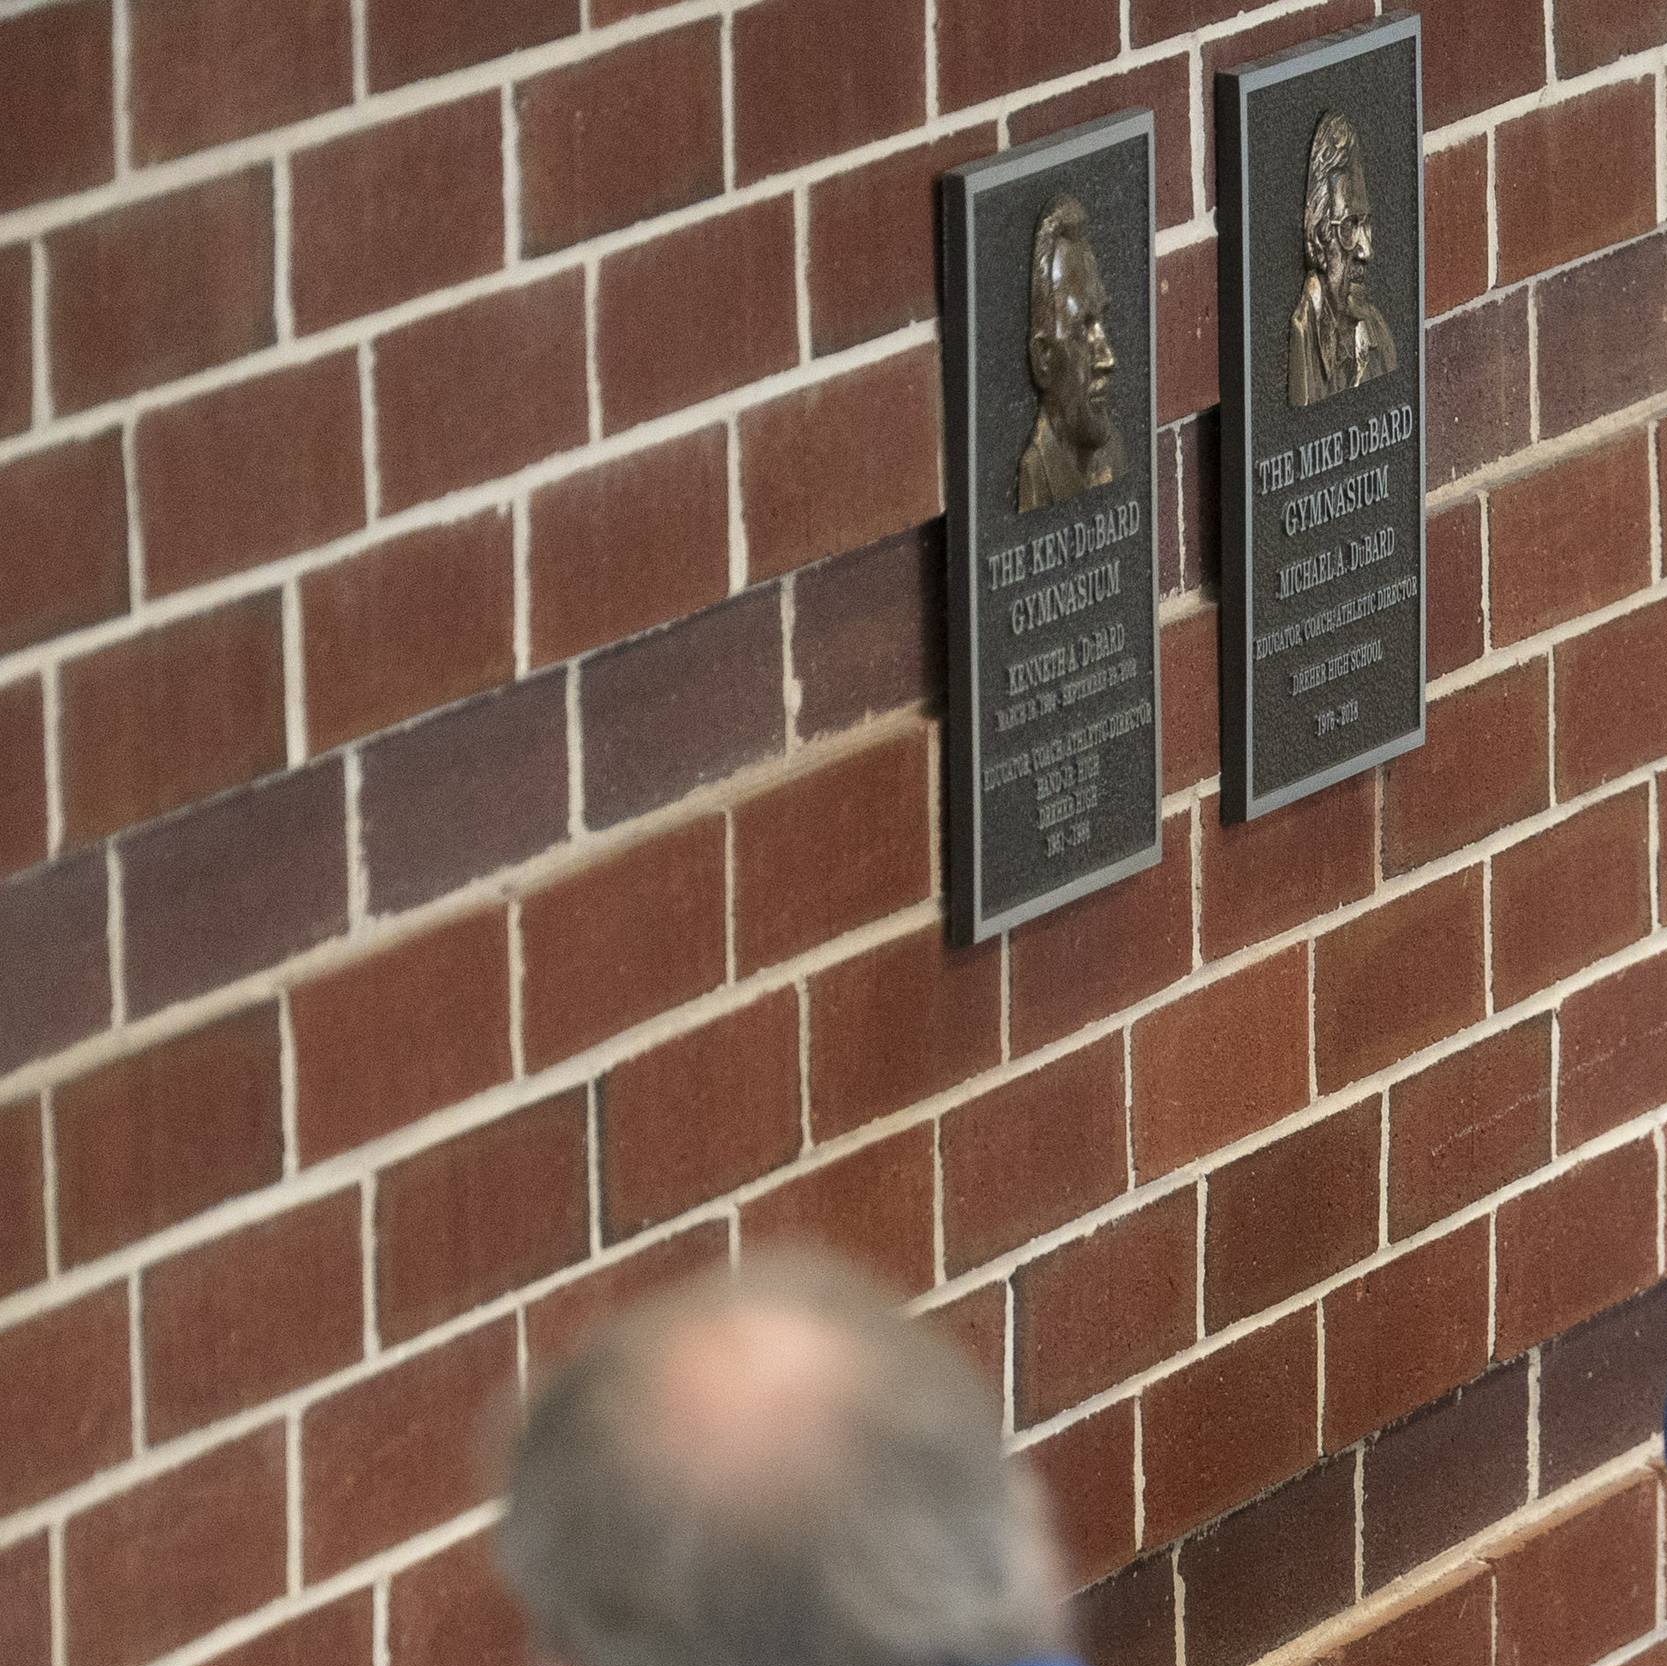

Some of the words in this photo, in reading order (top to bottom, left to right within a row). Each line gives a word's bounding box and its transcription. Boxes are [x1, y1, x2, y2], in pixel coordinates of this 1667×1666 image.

[1259, 450, 1295, 495] THE
[1299, 431, 1344, 480] MIKE
[1348, 404, 1413, 461] DuBARD
[1285, 465, 1389, 537] GYMNASIUM
[988, 545, 1026, 590] THE
[1032, 528, 1068, 575] KEN
[1074, 501, 1140, 559] DuBARD
[1279, 551, 1335, 600] MICHAEL
[1336, 548, 1348, 578] A.
[1350, 527, 1395, 571] DuBARD
[1012, 560, 1121, 635] GYMNASIUM
[1255, 624, 1303, 662] EDUCATOR,
[1335, 592, 1376, 627] ATHLETIC
[1377, 575, 1418, 612] DIRECTOR
[1009, 648, 1066, 696] KENNETH
[1291, 664, 1327, 697] DREHER
[1328, 653, 1350, 681] HIGH
[1350, 640, 1383, 672] SCHOOL
